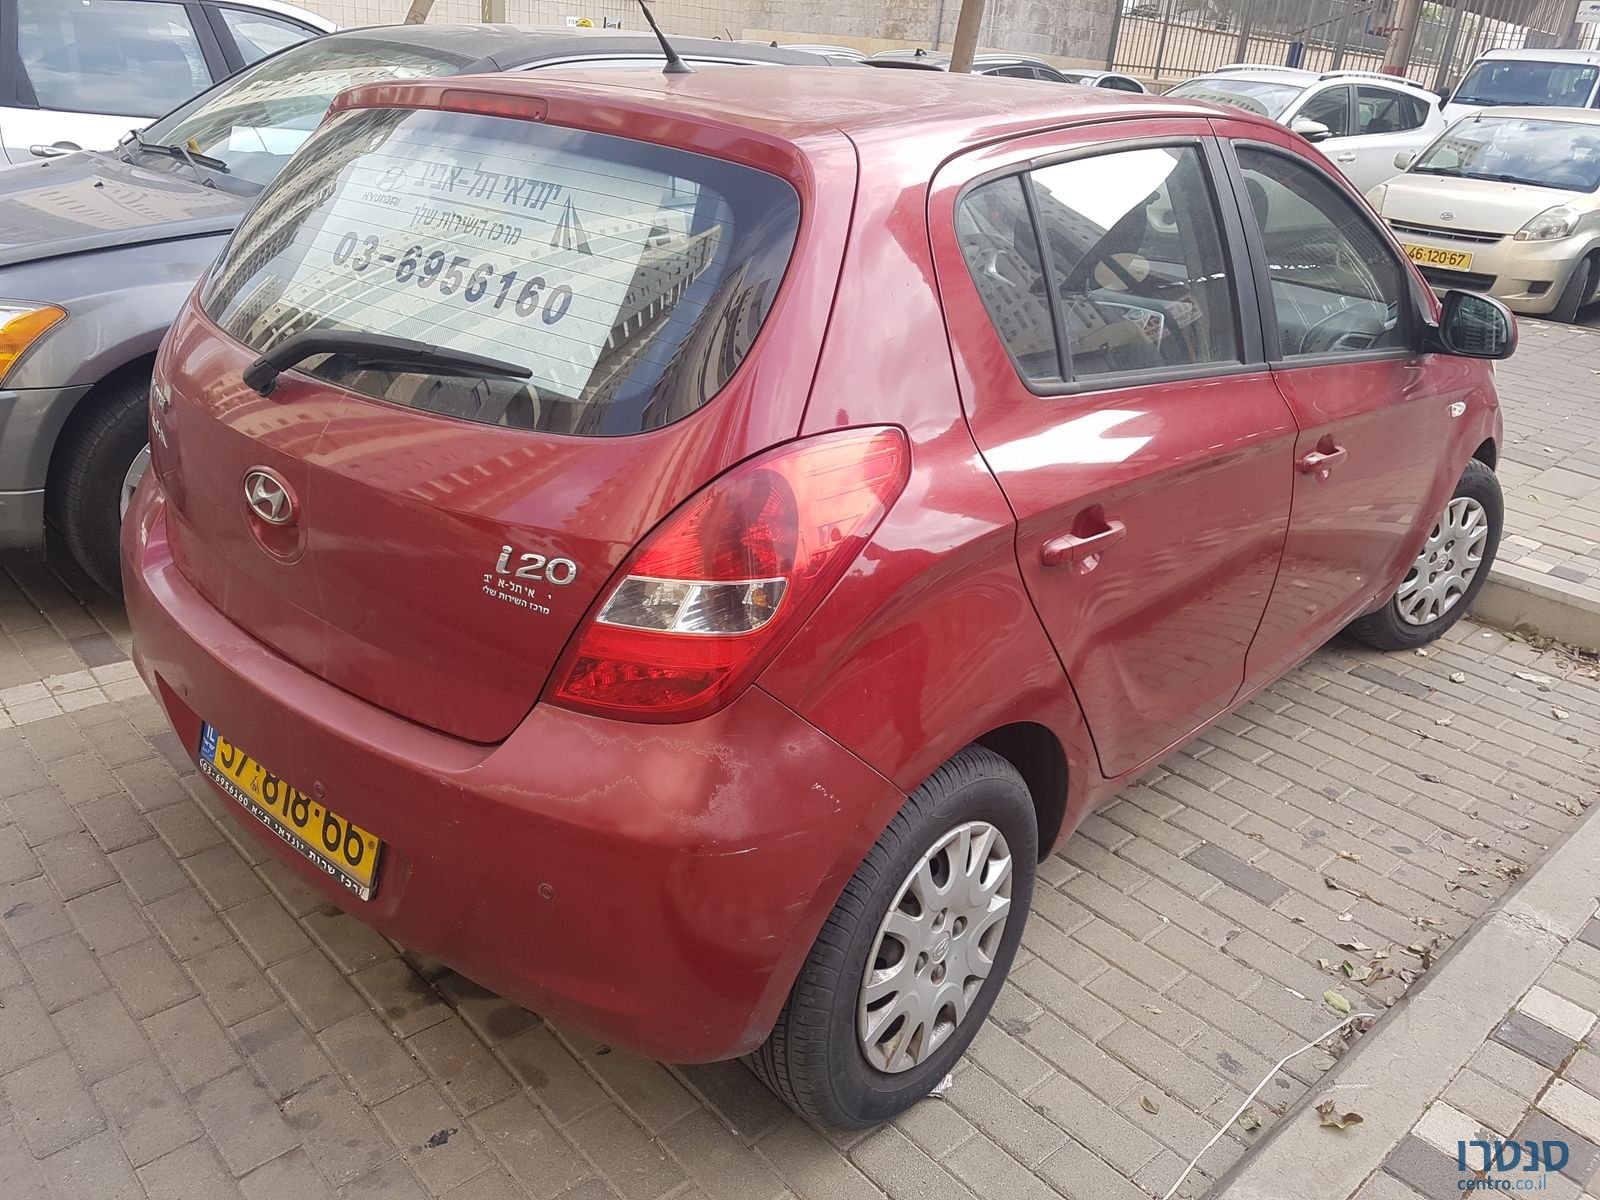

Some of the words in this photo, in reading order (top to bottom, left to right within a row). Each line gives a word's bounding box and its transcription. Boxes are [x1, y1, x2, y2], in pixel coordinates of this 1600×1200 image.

[414, 162, 500, 200] תל-אביב
[503, 175, 563, 211] יונדאי
[409, 203, 438, 228] שלך
[488, 222, 522, 246] מרכז
[332, 231, 573, 326] 03-6956160
[496, 545, 577, 585] i20
[201, 761, 249, 806] 03-6956160
[274, 825, 304, 850] יונדאי
[308, 850, 336, 875] שרות
